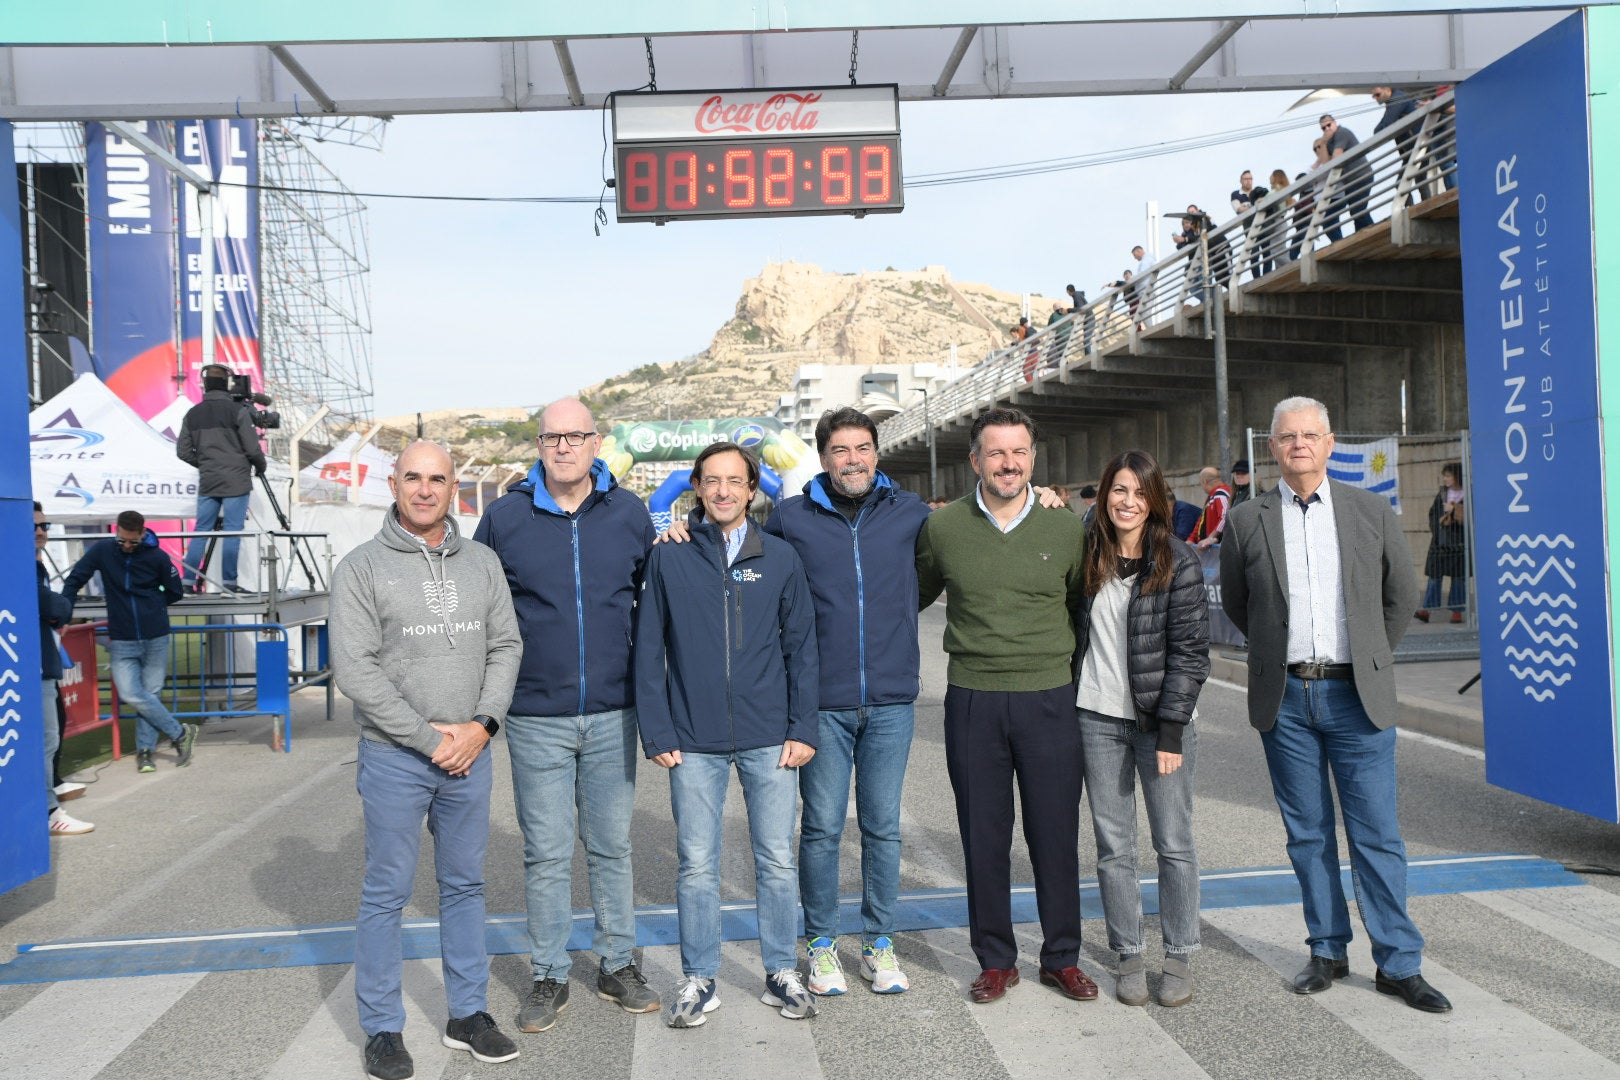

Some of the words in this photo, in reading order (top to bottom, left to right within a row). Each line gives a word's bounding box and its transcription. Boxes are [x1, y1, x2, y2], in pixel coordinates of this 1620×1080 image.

[695, 92, 822, 133] Coca-Cola
[688, 145, 891, 207] 1:52:53
[188, 274, 248, 291] MELLE
[1534, 193, 1551, 356] ATLÉTICO
[1496, 154, 1530, 513] MONTEMAR
[1540, 375, 1554, 461] CLUB
[659, 431, 729, 451] Coplaca
[101, 479, 197, 495] Alicante
[402, 620, 481, 637] MONTMAR
